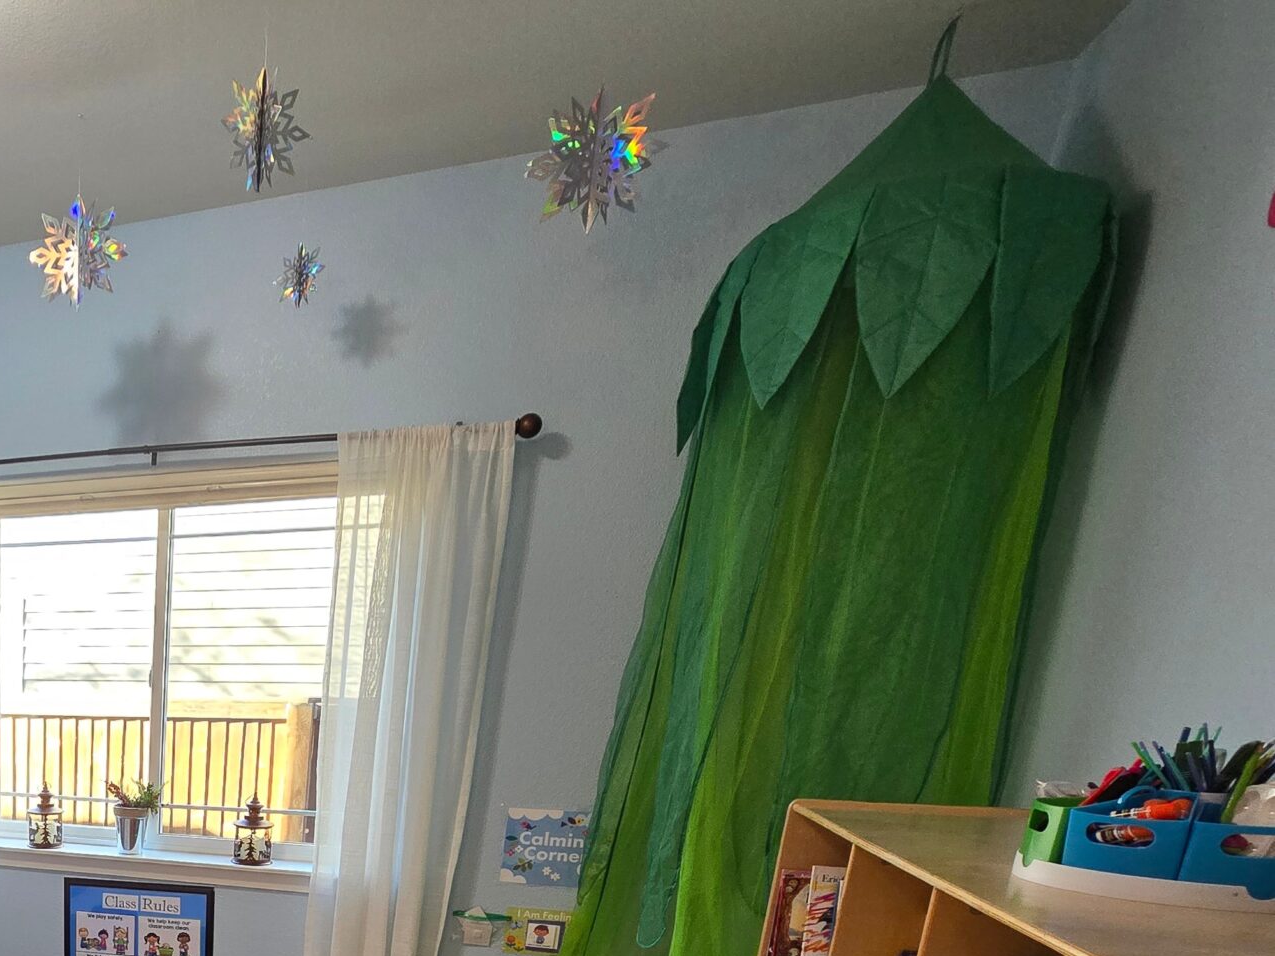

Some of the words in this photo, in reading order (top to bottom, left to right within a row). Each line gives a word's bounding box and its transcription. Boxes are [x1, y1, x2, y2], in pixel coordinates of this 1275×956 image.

[519, 831, 585, 848] Calmin
[524, 846, 583, 863] Corne
[104, 895, 137, 909] Class
[142, 898, 179, 913] Rules
[523, 910, 541, 920] Am
[543, 911, 573, 921] Feelin
